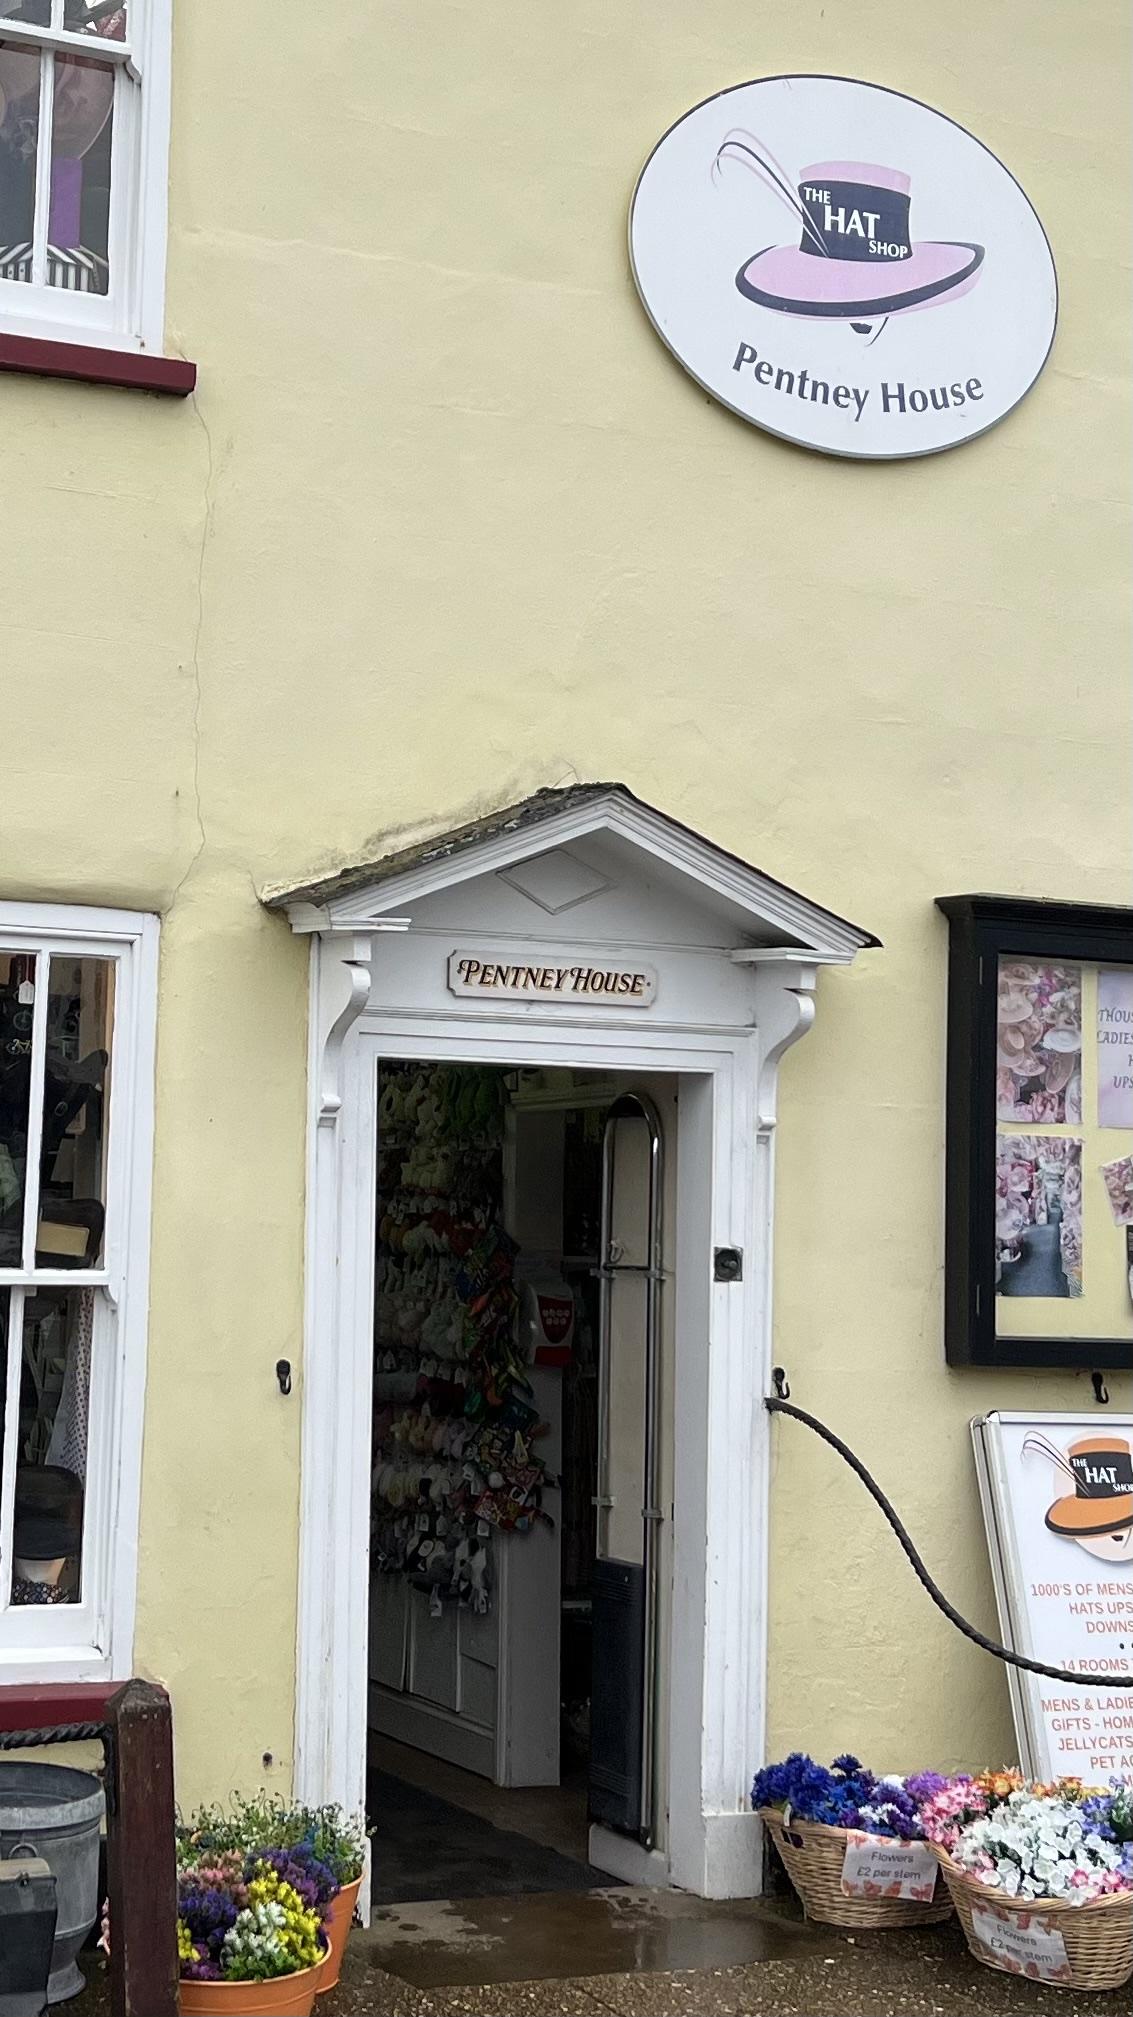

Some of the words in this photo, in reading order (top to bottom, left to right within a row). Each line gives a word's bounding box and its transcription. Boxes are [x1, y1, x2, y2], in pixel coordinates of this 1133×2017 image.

[803, 186, 831, 204] THE
[824, 204, 881, 239] HAT
[868, 240, 908, 258] SHOP
[732, 342, 870, 422] Pentney
[881, 377, 984, 413] House
[458, 959, 570, 992] PENTNEY
[570, 967, 646, 995] HOUSE
[1071, 1458, 1088, 1467] THE
[1084, 1466, 1117, 1484] HAT
[1031, 1583, 1072, 1596] 1000'S
[1075, 1583, 1093, 1596] OF
[1097, 1582, 1133, 1596] MENS
[1069, 1602, 1104, 1615] HATS
[1061, 1660, 1076, 1671] 14
[1079, 1658, 1129, 1672] ROOMS
[1041, 1698, 1081, 1712] MENS
[1084, 1697, 1094, 1711] &
[1051, 1717, 1092, 1732] GIFTS
[1058, 1735, 1133, 1751] JELLYCATS
[1090, 1755, 1116, 1769] PET
[871, 1852, 914, 1863] Flowers
[857, 1866, 872, 1877] £2
[873, 1869, 892, 1878] per
[894, 1869, 921, 1880] stem
[997, 1924, 1038, 1946] Flowers
[990, 1936, 1005, 1949] £2
[1024, 1951, 1053, 1963] stem
